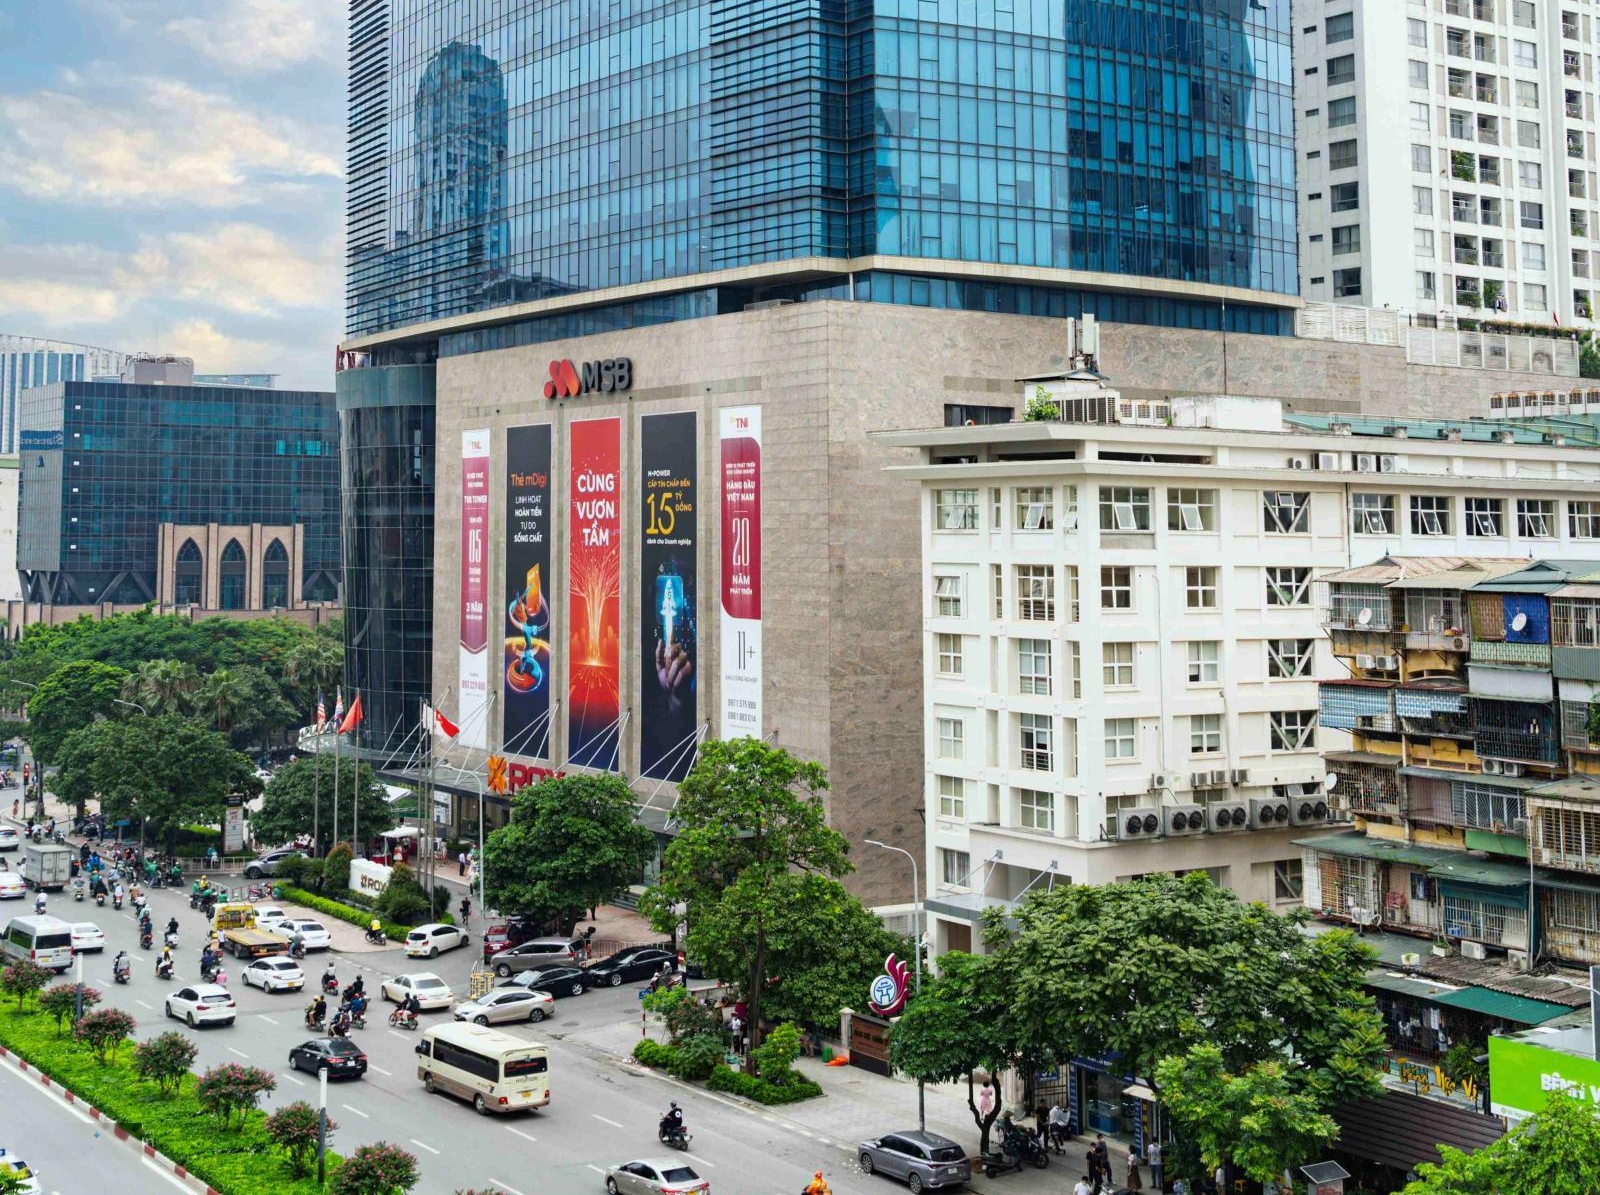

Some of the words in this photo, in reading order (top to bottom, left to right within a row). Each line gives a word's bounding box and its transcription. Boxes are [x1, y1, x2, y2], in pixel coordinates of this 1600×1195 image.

[581, 357, 633, 394] MSB
[577, 469, 615, 493] CÙNG
[576, 498, 615, 520] VƯƠN
[646, 492, 675, 535] 15
[468, 529, 482, 563] 05
[582, 518, 609, 546] TẦM
[732, 517, 750, 566] 20
[732, 572, 750, 585] NĂM
